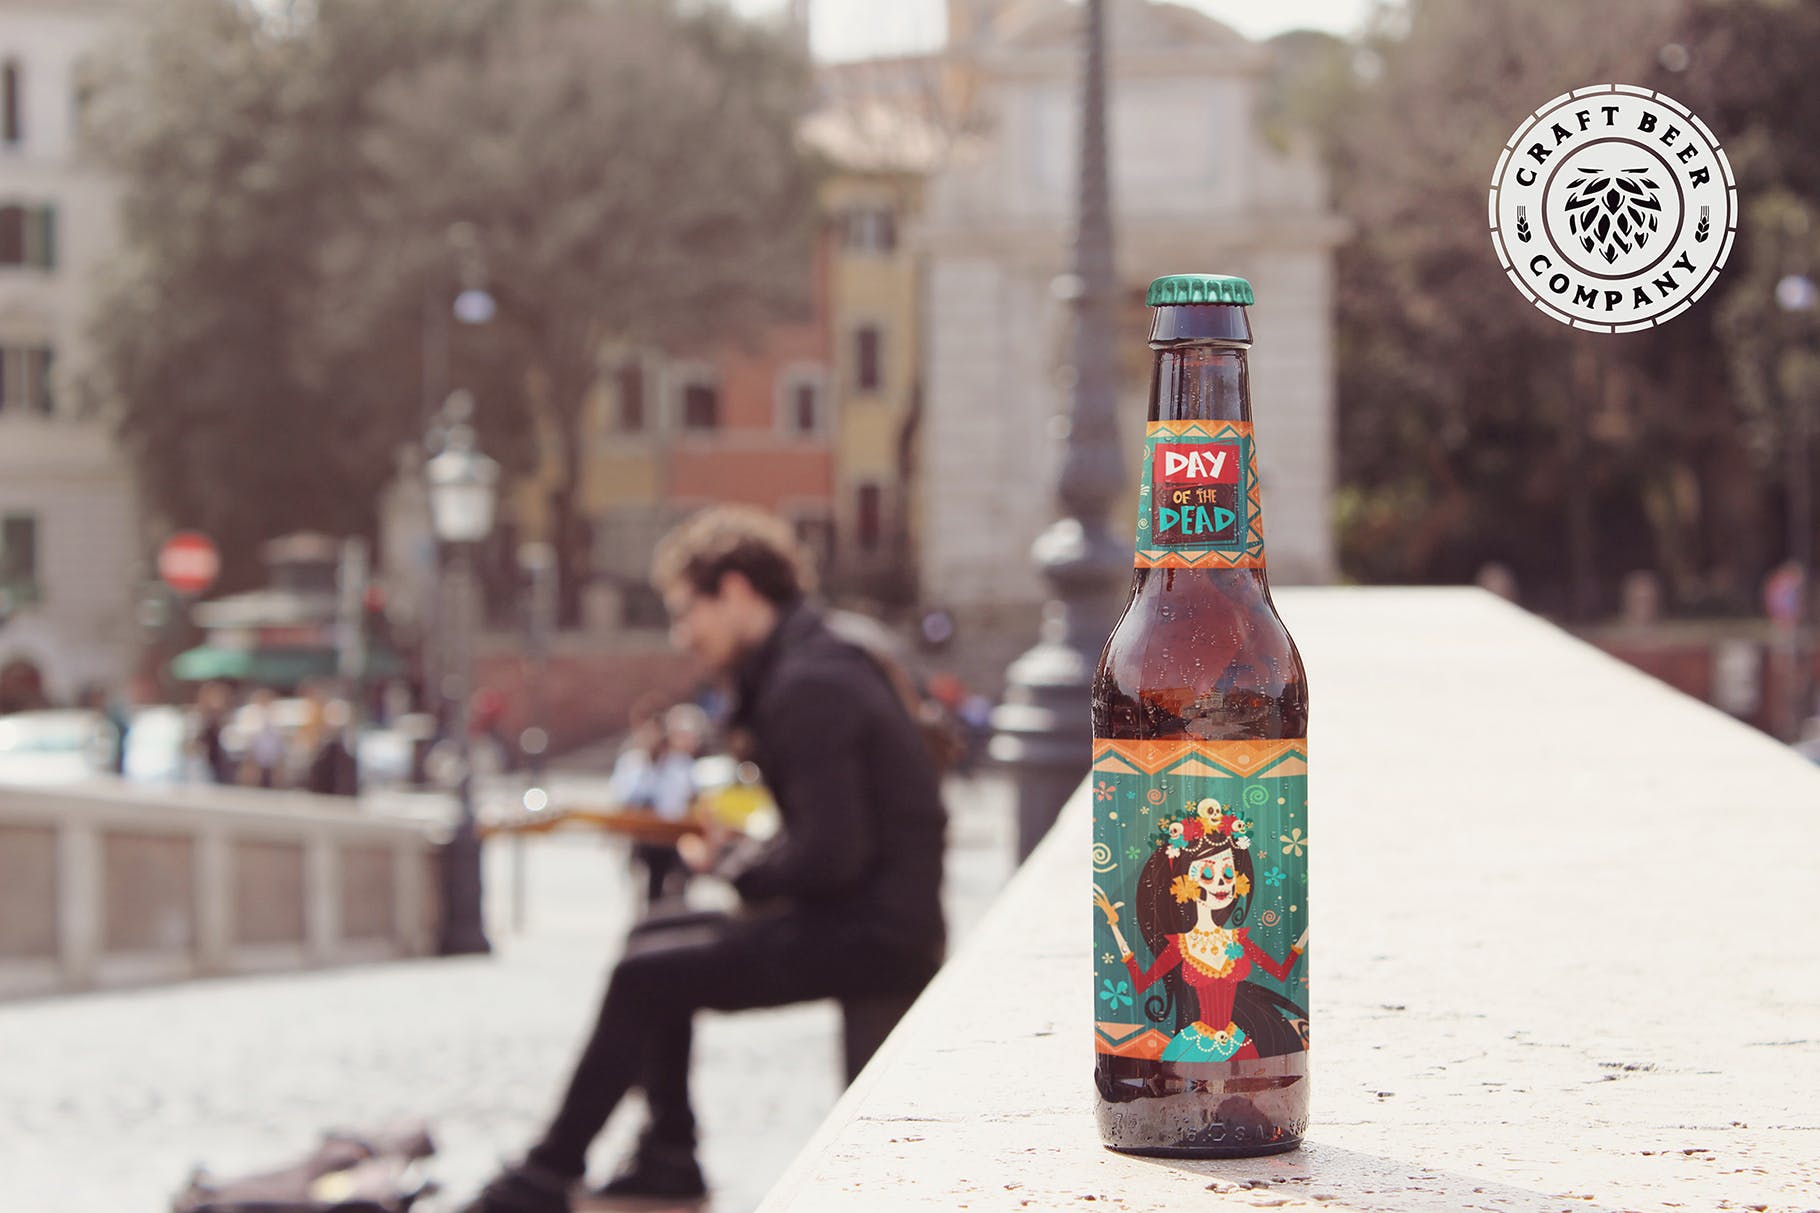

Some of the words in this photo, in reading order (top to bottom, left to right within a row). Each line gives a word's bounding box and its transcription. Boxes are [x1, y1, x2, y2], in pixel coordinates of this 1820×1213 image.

[1165, 451, 1227, 478] DAY
[1172, 490, 1191, 504] OF
[1195, 489, 1217, 503] THE
[1159, 505, 1236, 534] DEAD
